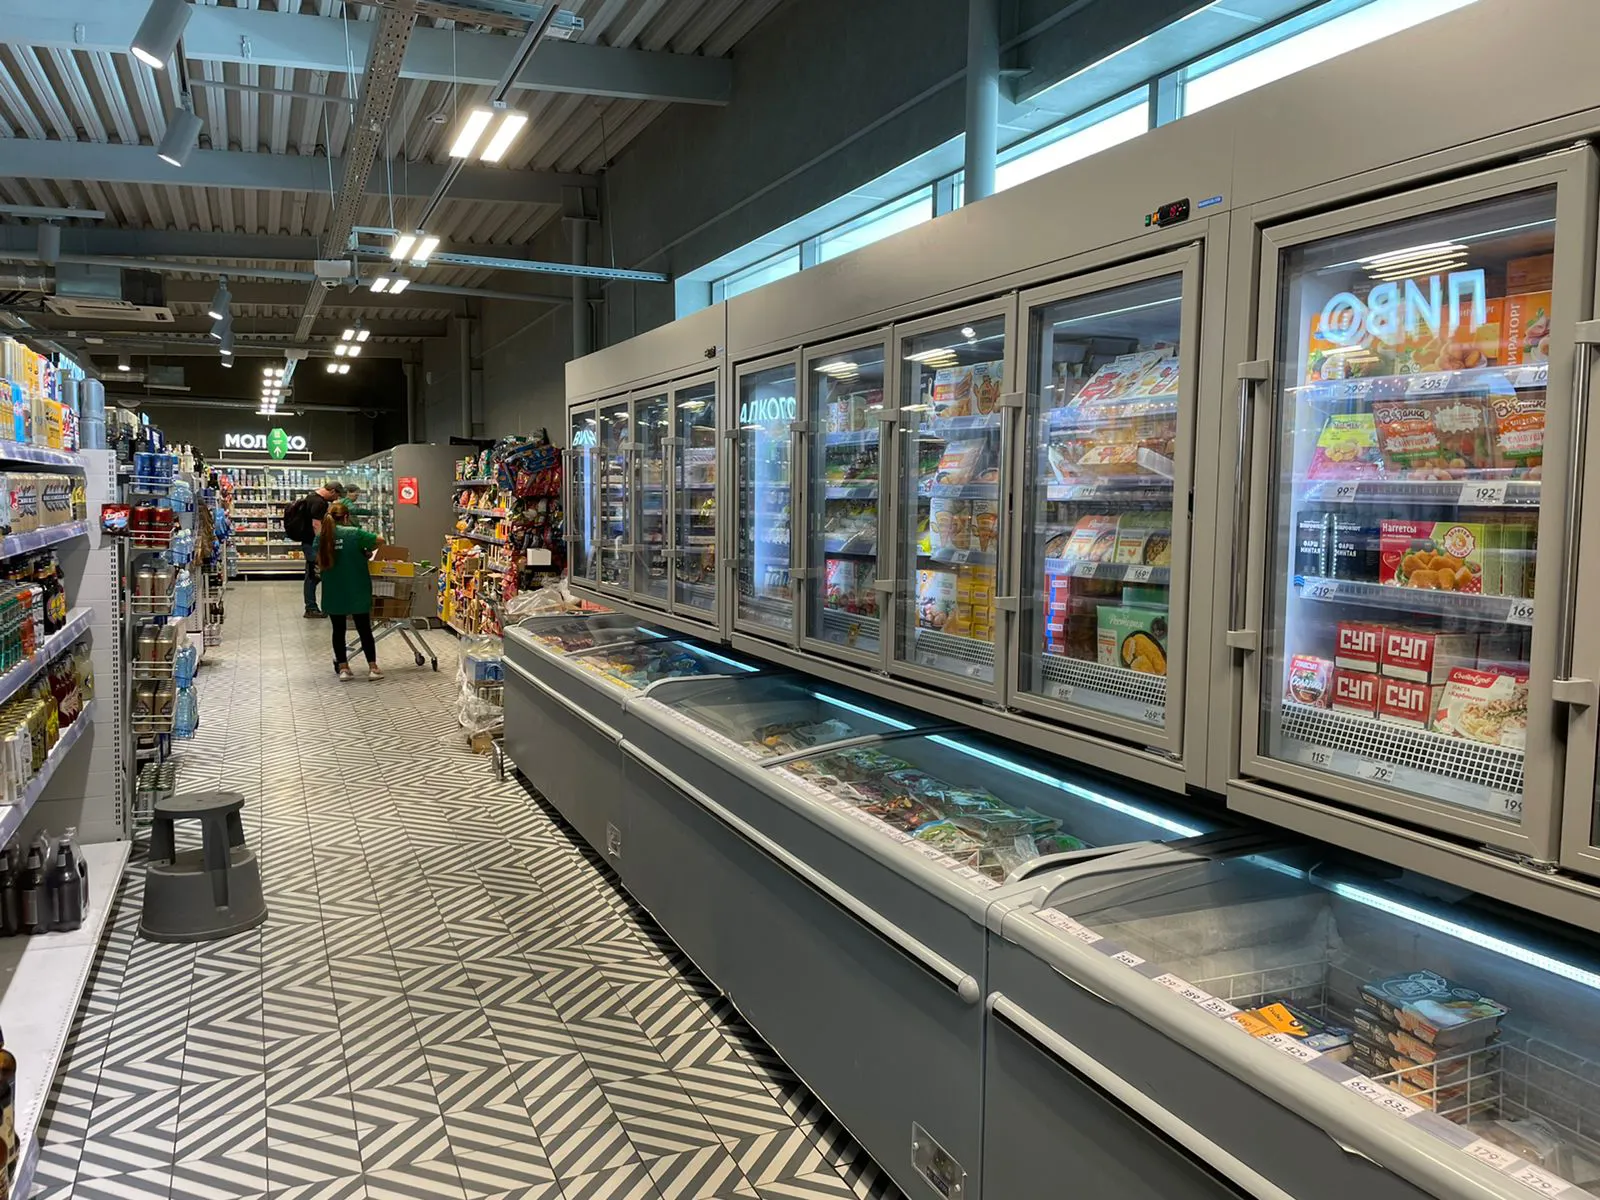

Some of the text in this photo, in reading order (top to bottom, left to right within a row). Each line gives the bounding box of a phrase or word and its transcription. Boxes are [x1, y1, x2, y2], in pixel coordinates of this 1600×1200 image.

[1475, 488, 1496, 499] 192
[1382, 522, 1417, 534] Наггетсы
[1513, 605, 1534, 617] 169
[1340, 629, 1376, 653] СУП
[1387, 635, 1428, 660] СУП
[1337, 677, 1373, 702] СУП
[1385, 684, 1425, 711] СУП
[1351, 1081, 1377, 1095] 667
[1383, 1098, 1410, 1113] 635
[1473, 1145, 1499, 1160] 179
[1521, 1172, 1553, 1189] 279
